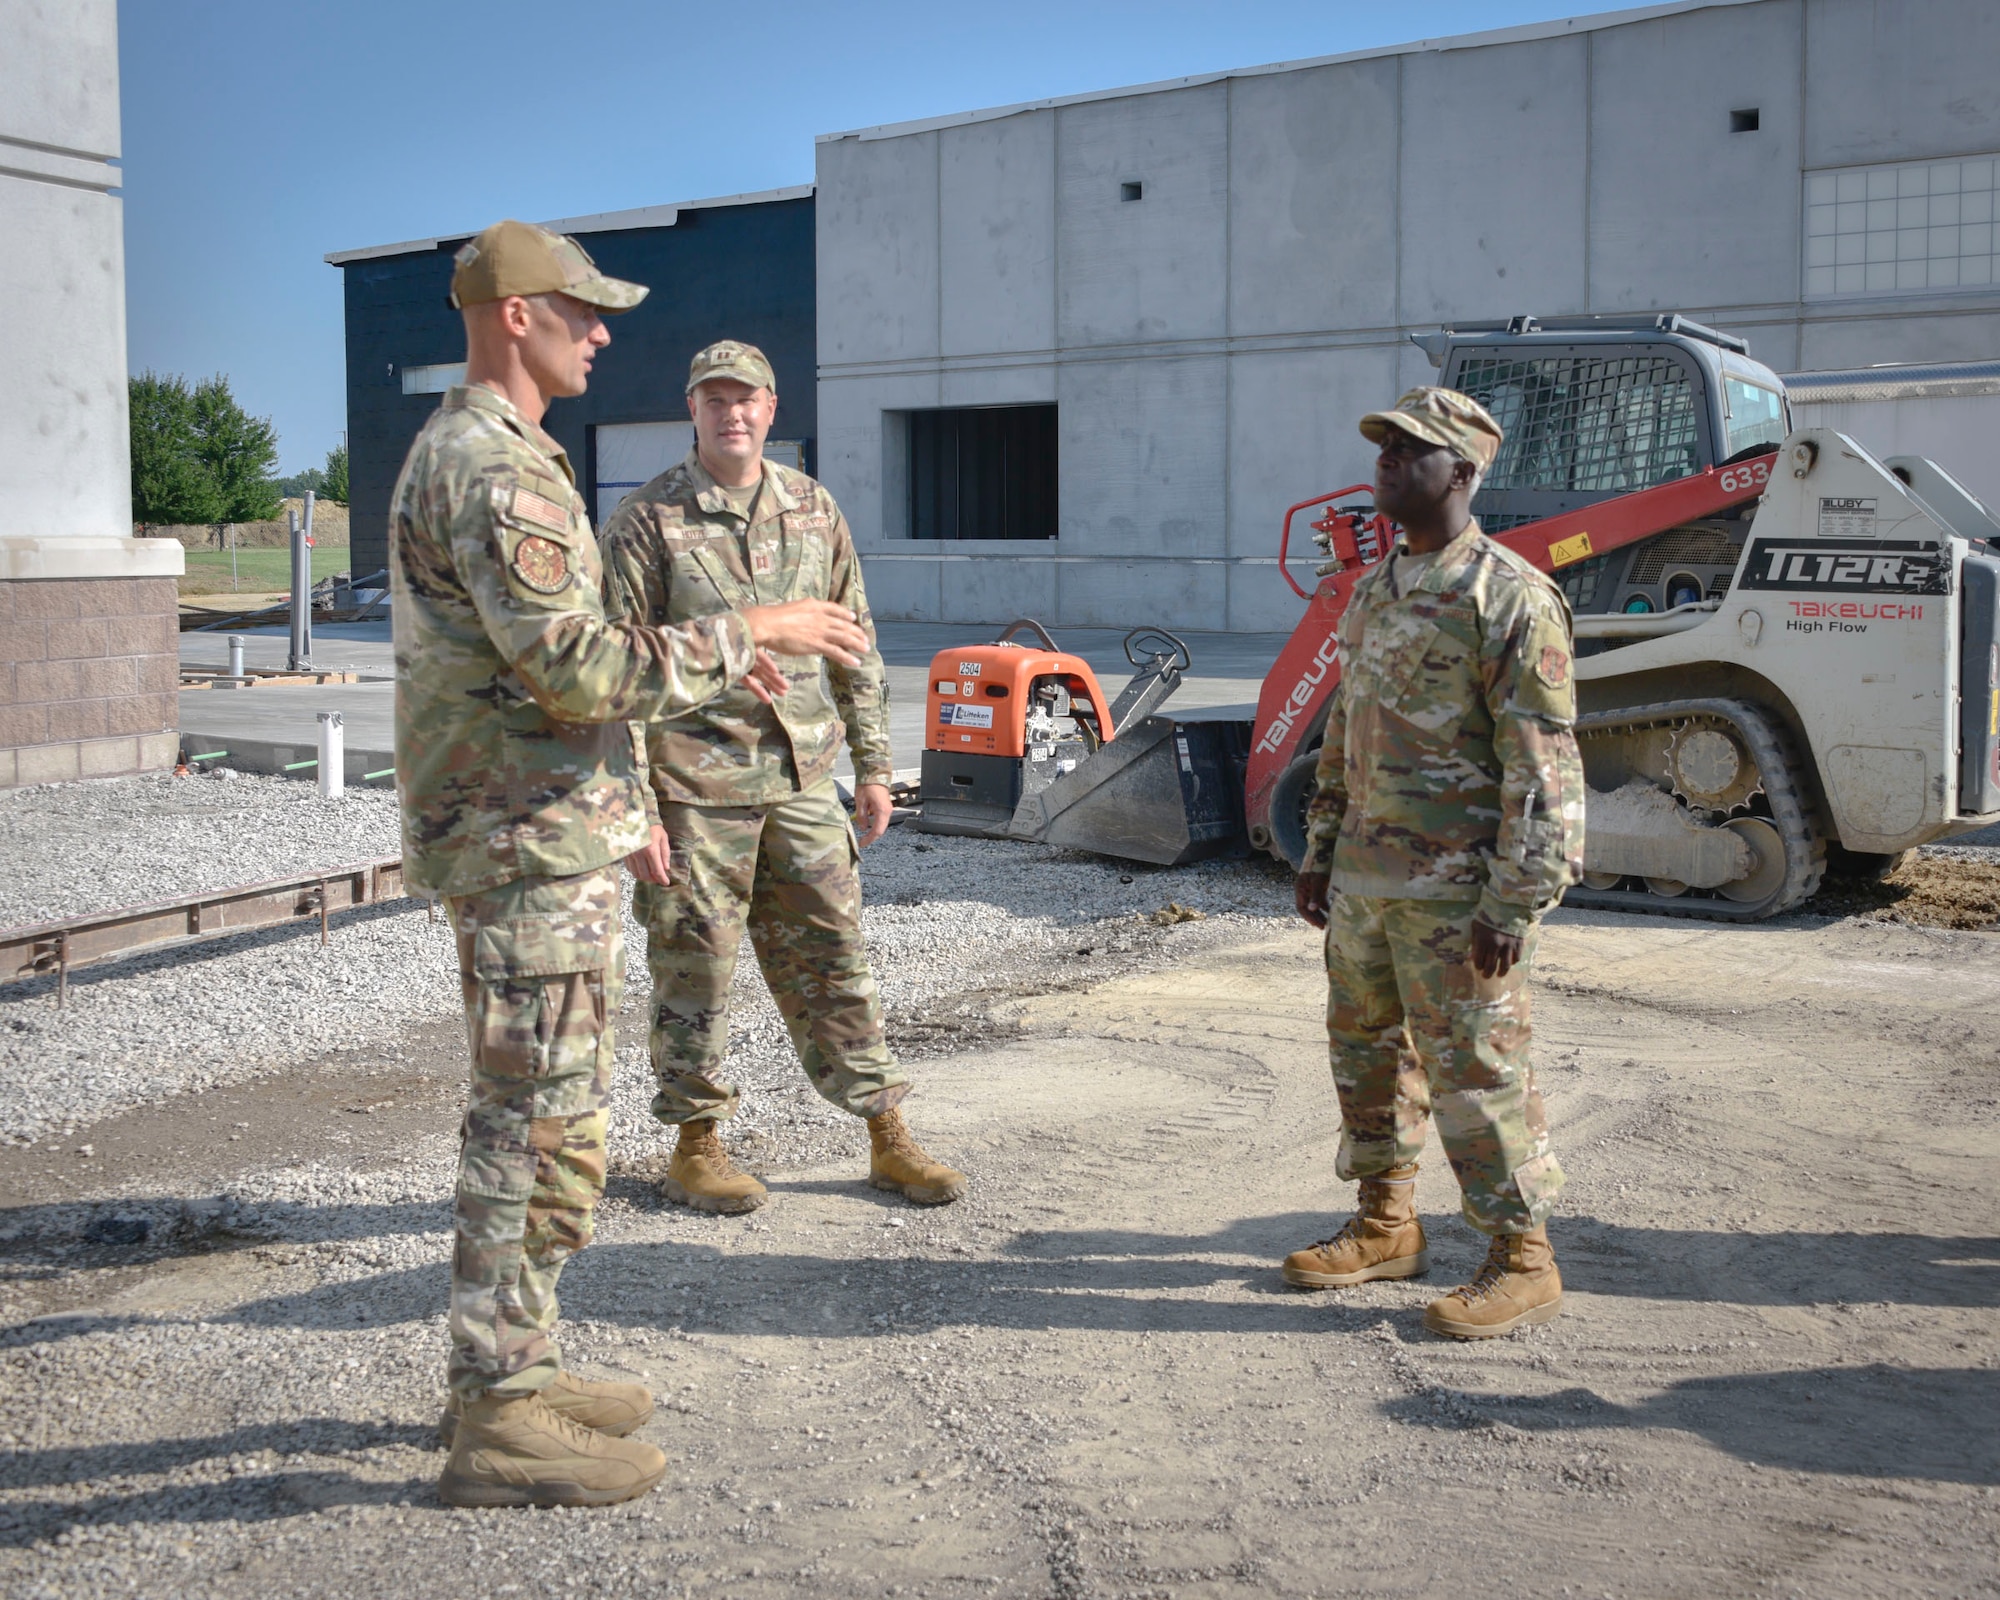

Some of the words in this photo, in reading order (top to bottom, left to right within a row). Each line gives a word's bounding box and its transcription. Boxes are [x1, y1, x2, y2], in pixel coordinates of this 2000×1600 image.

[1720, 462, 1769, 492] 633
[1830, 499, 1863, 508] LUBY
[1764, 548, 1930, 585] TL12R2
[1786, 620, 1823, 633] High
[1829, 621, 1867, 633] Flow
[960, 663, 980, 675] 2504
[1255, 631, 1339, 754] TAKEUC
